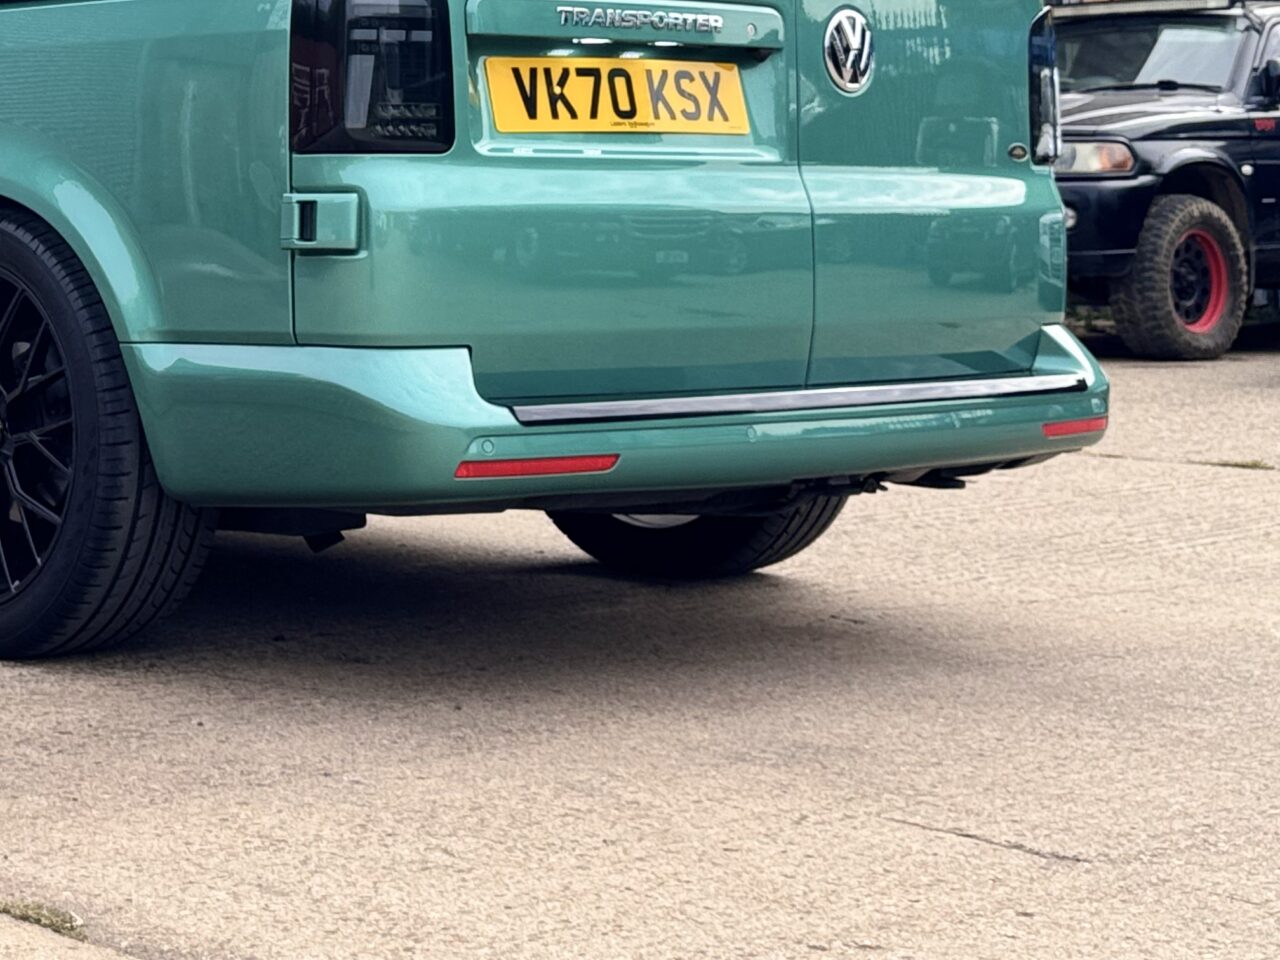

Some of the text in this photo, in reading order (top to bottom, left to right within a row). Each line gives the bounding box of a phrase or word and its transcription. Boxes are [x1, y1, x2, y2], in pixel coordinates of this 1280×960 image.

[557, 6, 725, 34] TRANSPORTER
[511, 66, 730, 123] VK70 KSX
